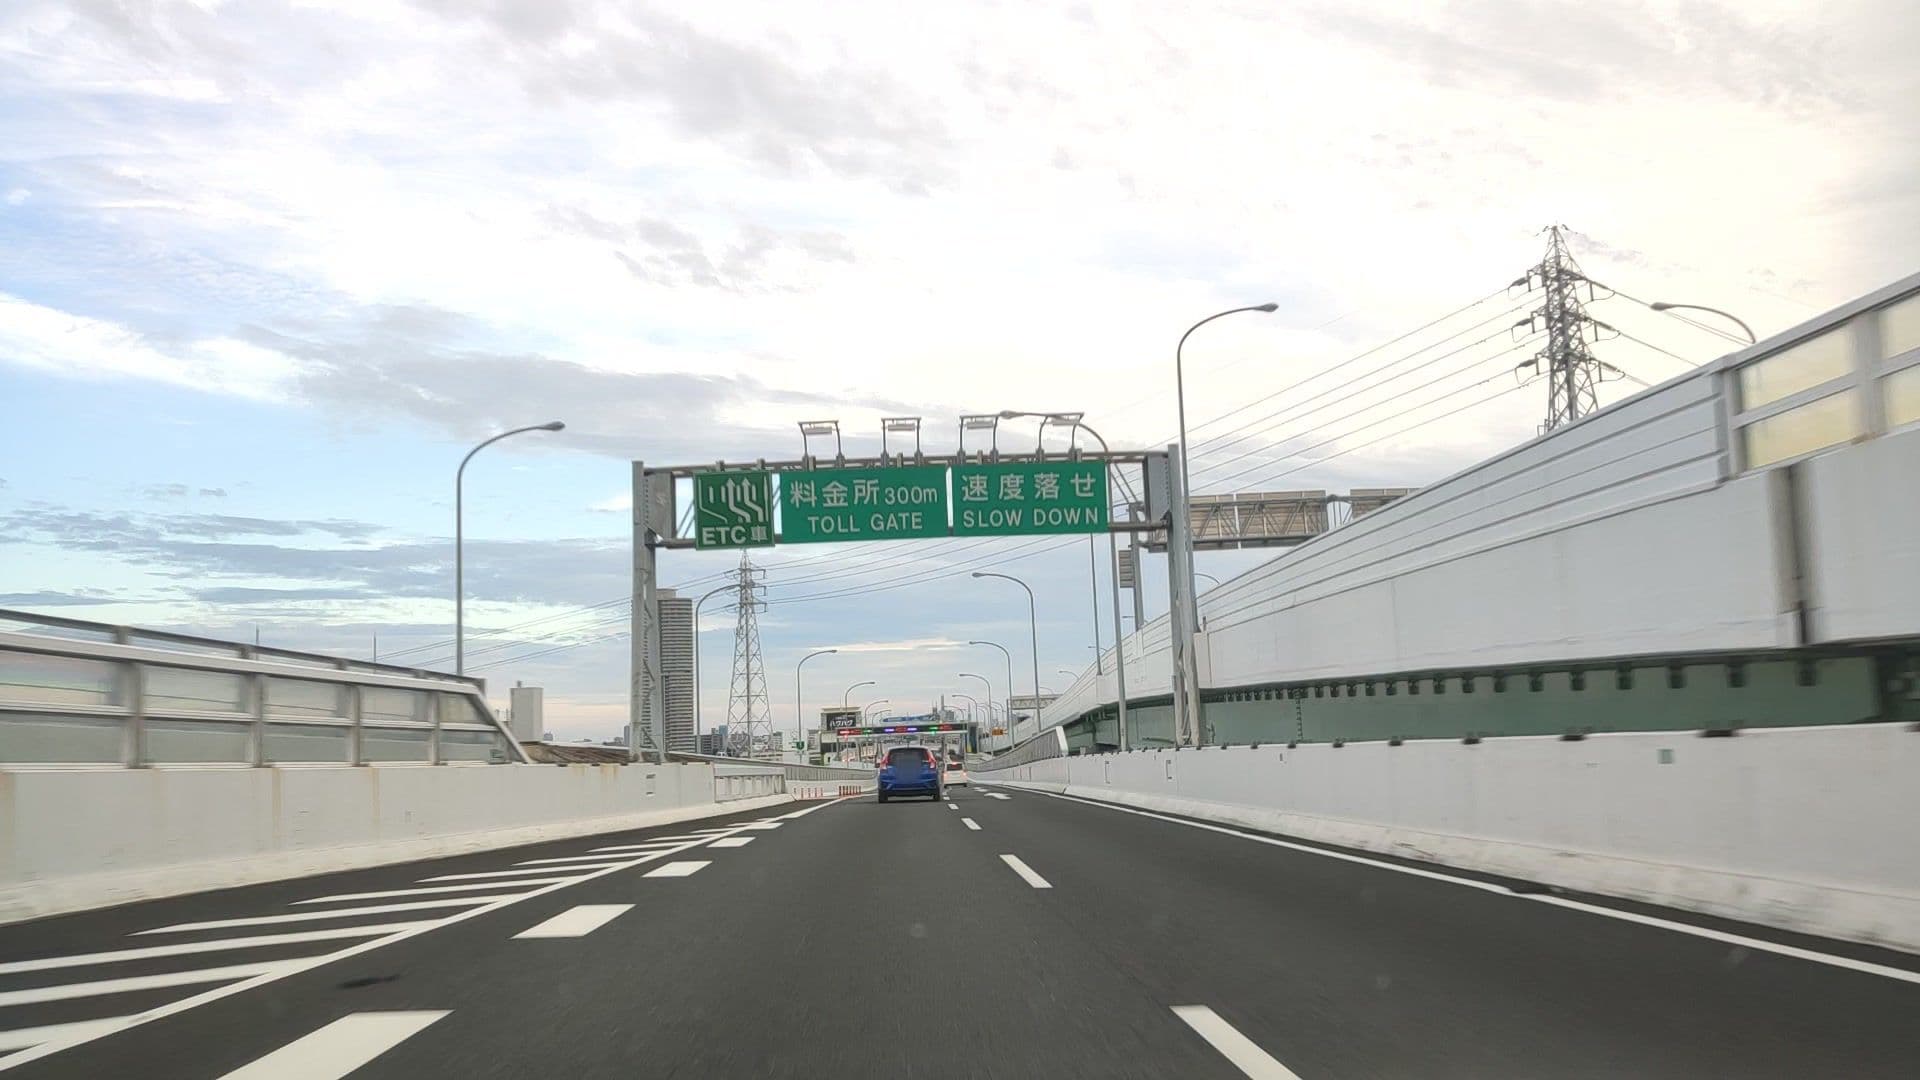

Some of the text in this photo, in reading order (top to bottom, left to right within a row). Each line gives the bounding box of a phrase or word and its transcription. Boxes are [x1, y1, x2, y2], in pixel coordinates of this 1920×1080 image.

[961, 472, 1097, 501] 速度落せ
[807, 512, 923, 534] TOLL GATE
[963, 507, 1098, 528] SLOW DOWN
